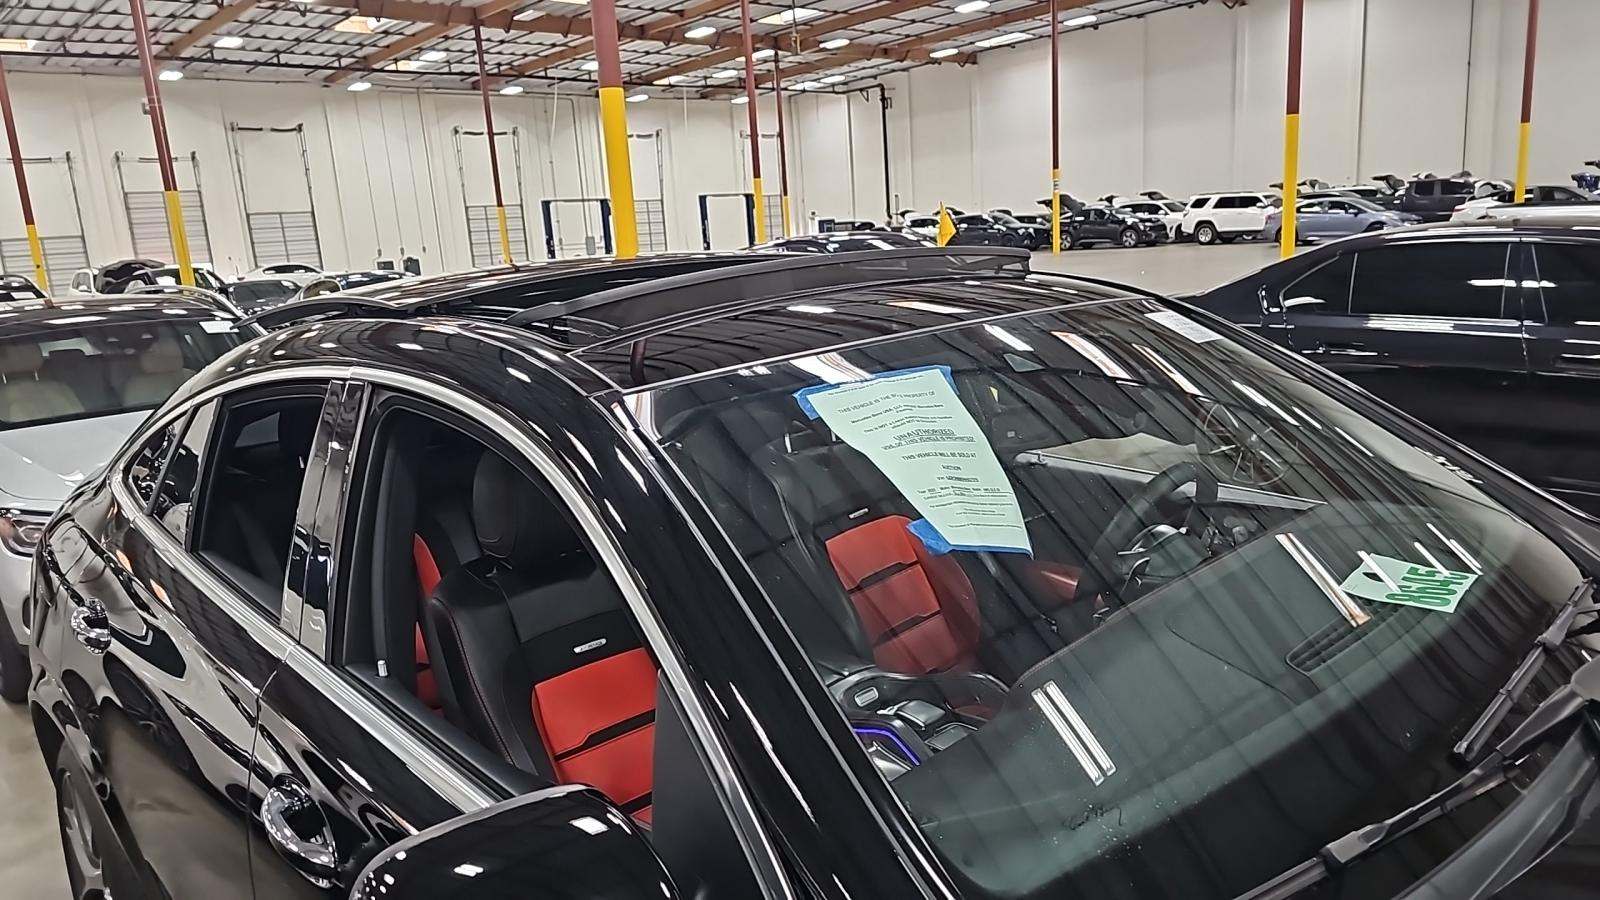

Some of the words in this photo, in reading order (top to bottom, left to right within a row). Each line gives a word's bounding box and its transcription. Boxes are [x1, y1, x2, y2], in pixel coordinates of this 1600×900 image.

[851, 400, 873, 410] VEHICLE
[893, 428, 955, 440] UNAUTHORIZED
[901, 453, 917, 461] THIS
[916, 450, 939, 459] VEHICLE
[938, 450, 951, 458] WILL
[1385, 566, 1470, 607] 8645
